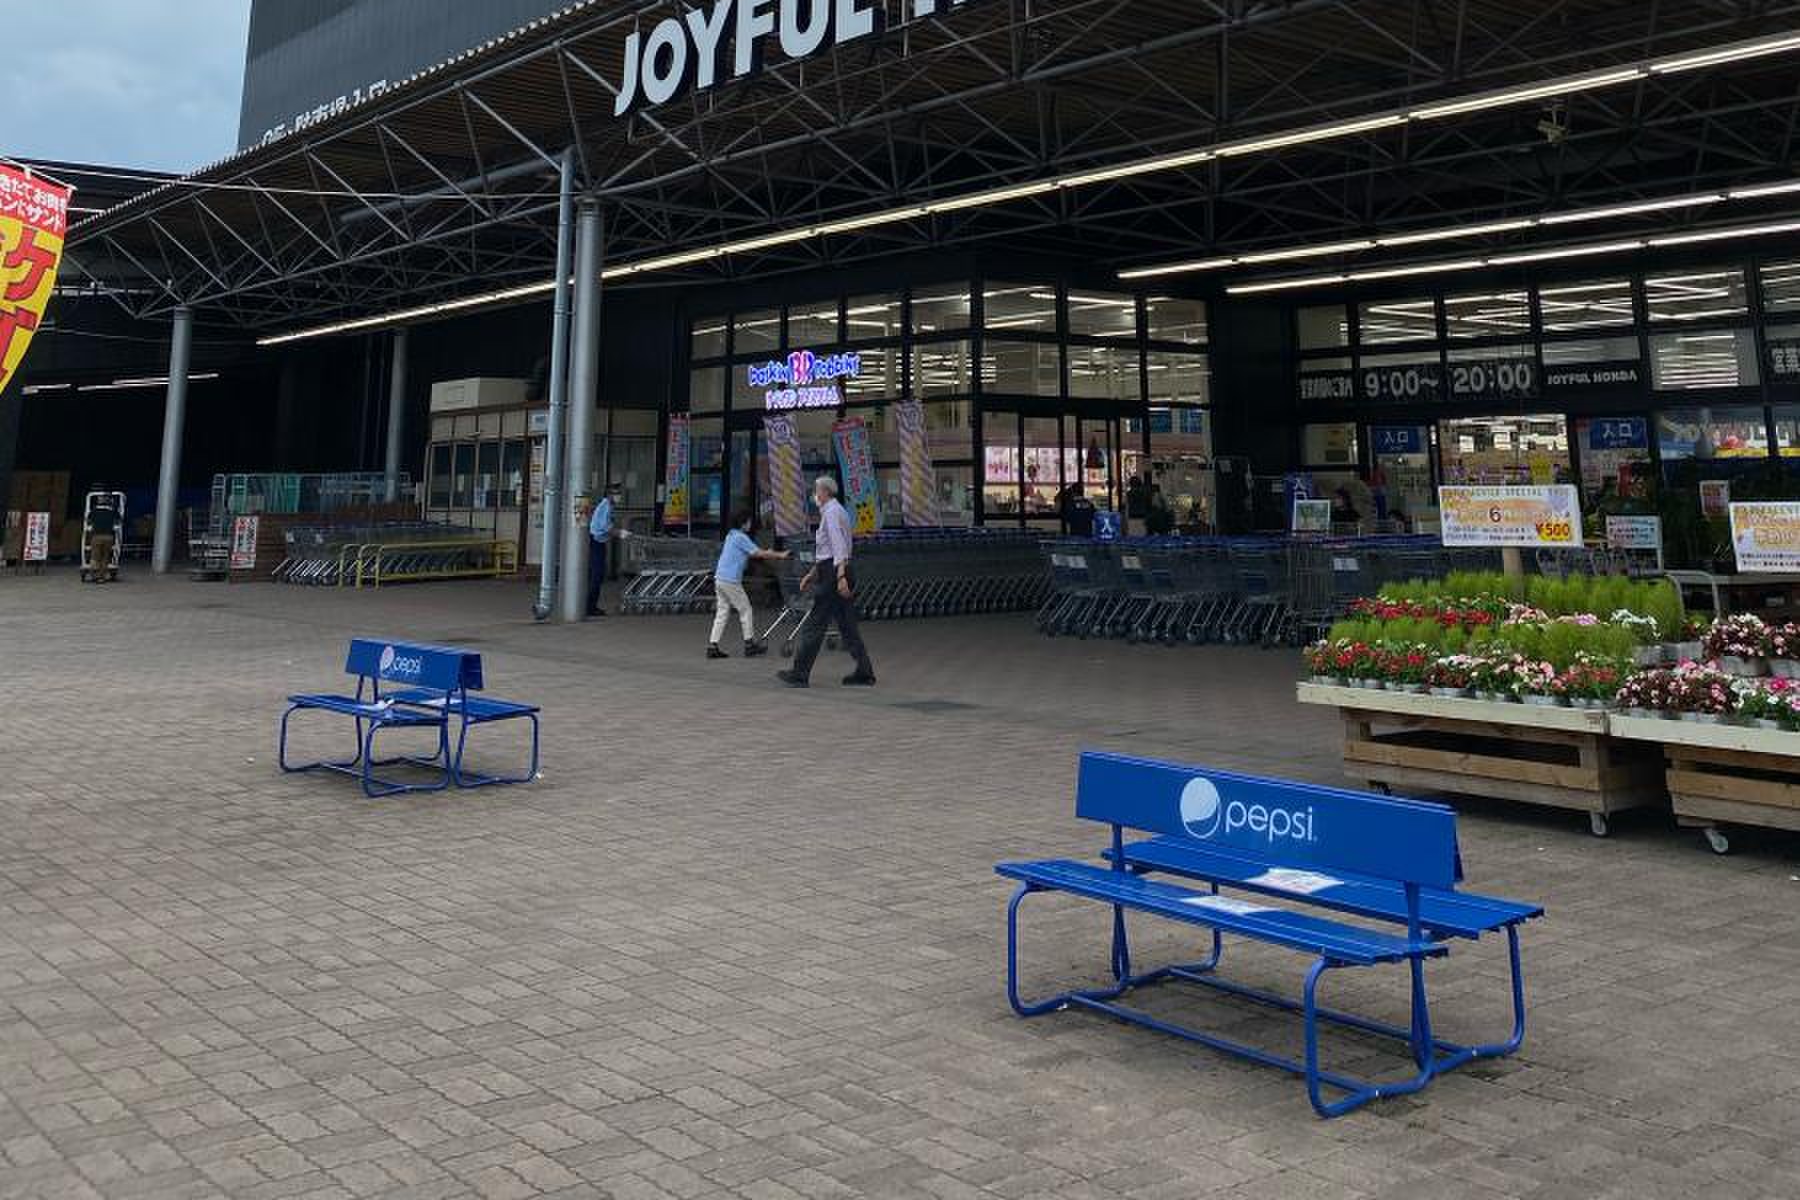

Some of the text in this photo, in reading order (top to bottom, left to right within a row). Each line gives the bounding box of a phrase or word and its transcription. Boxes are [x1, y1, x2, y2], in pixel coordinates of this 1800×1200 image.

[1453, 364, 1532, 393] 20:00
[1602, 422, 1633, 439] 入口
[1225, 800, 1314, 842] pepsi
